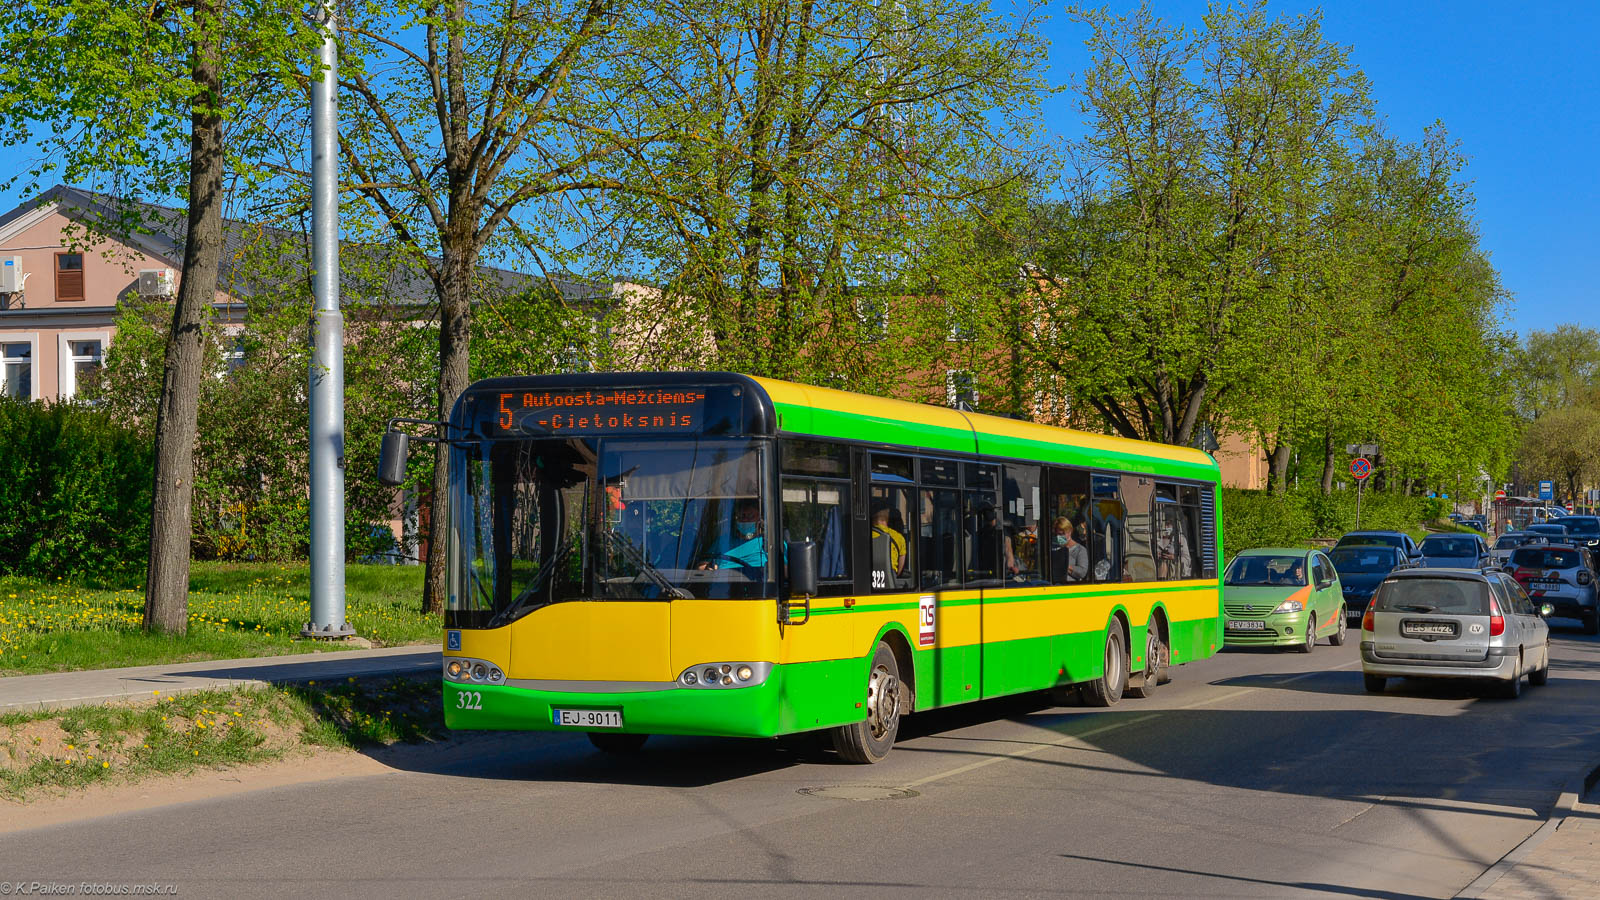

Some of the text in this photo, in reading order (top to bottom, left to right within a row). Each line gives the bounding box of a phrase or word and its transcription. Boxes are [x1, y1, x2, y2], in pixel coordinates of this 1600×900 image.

[499, 392, 514, 430] 5
[872, 570, 886, 588] 322
[456, 691, 483, 710] 322
[562, 711, 618, 726] EJ-9011
